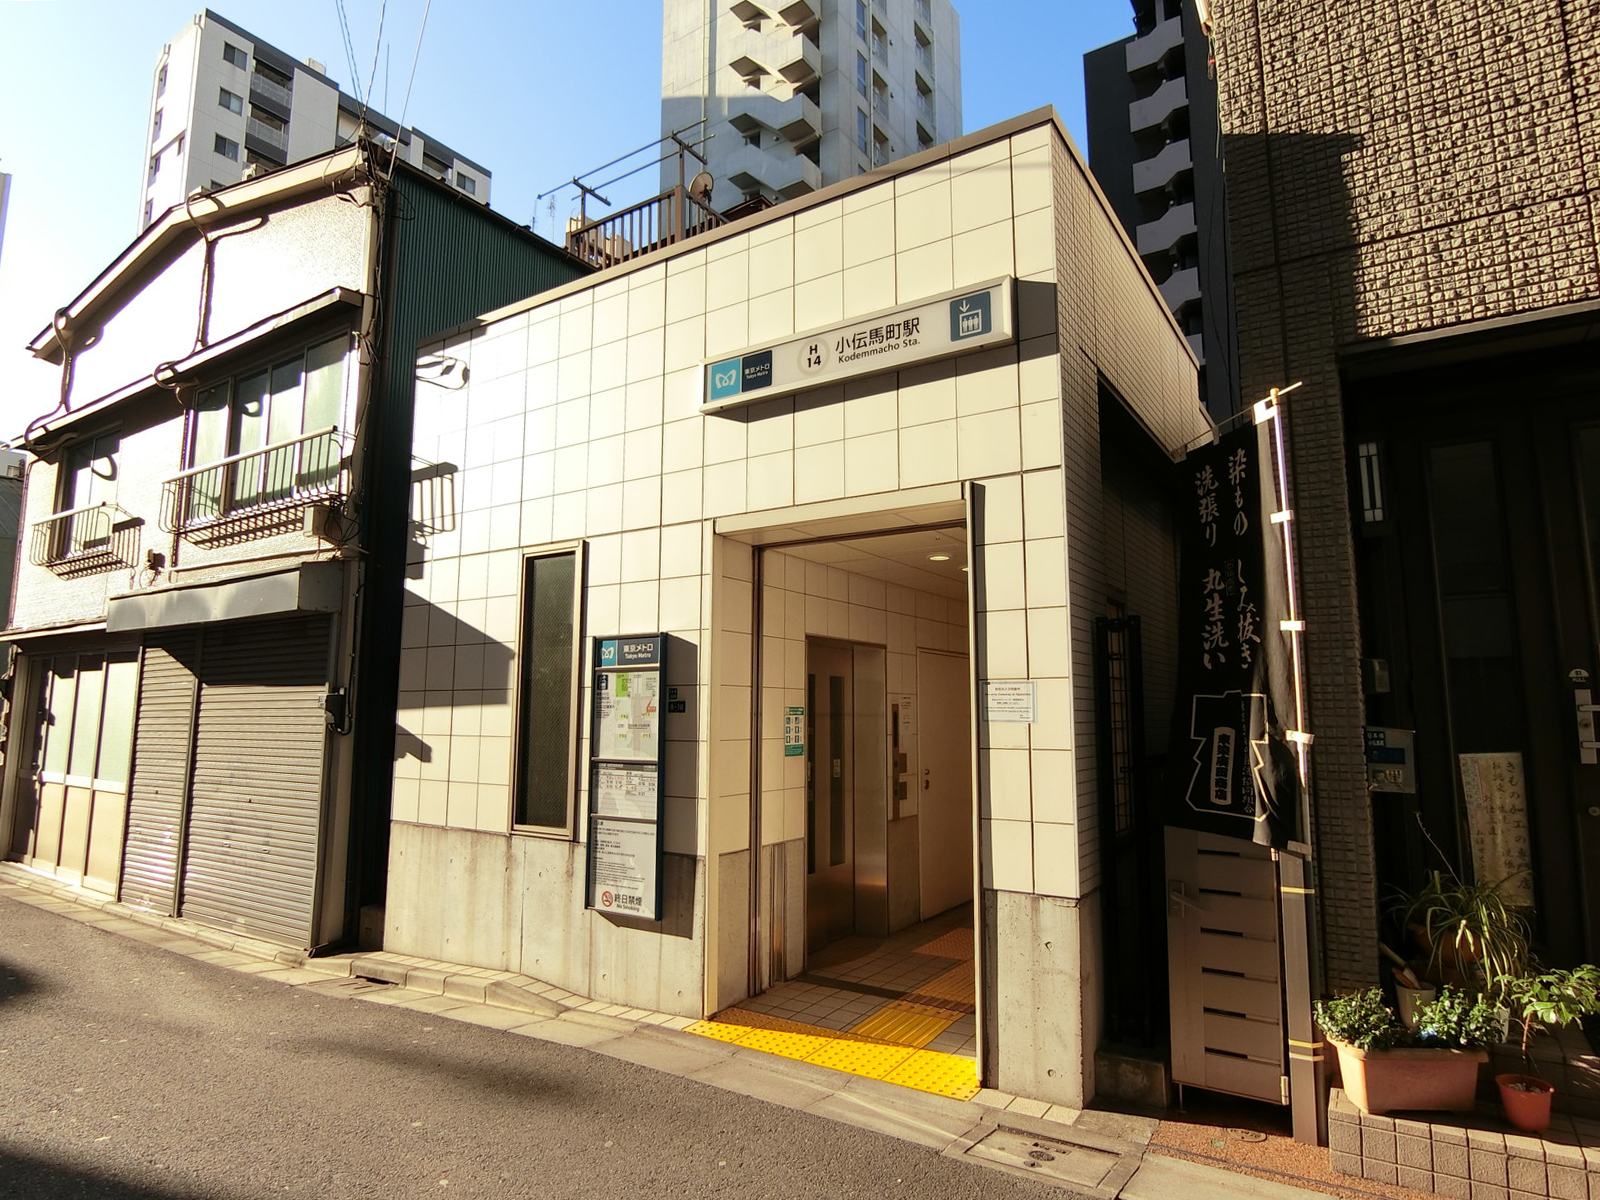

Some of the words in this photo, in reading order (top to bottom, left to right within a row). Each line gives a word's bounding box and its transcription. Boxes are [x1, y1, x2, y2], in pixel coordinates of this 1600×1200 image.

[835, 317, 920, 354] 小伝馬町駅
[808, 345, 819, 356] H
[838, 342, 900, 364] Kodemmacho
[902, 337, 921, 349] Sta.
[744, 363, 770, 375] 東京メトロ
[806, 357, 822, 369] 14
[1228, 447, 1249, 536] 染もの
[1194, 465, 1220, 548] 洗張り
[1201, 567, 1230, 671] 丸生洗い
[623, 643, 654, 653] 東京メトロ
[614, 893, 643, 906] 終日禁煙
[623, 904, 640, 913] Smoking
